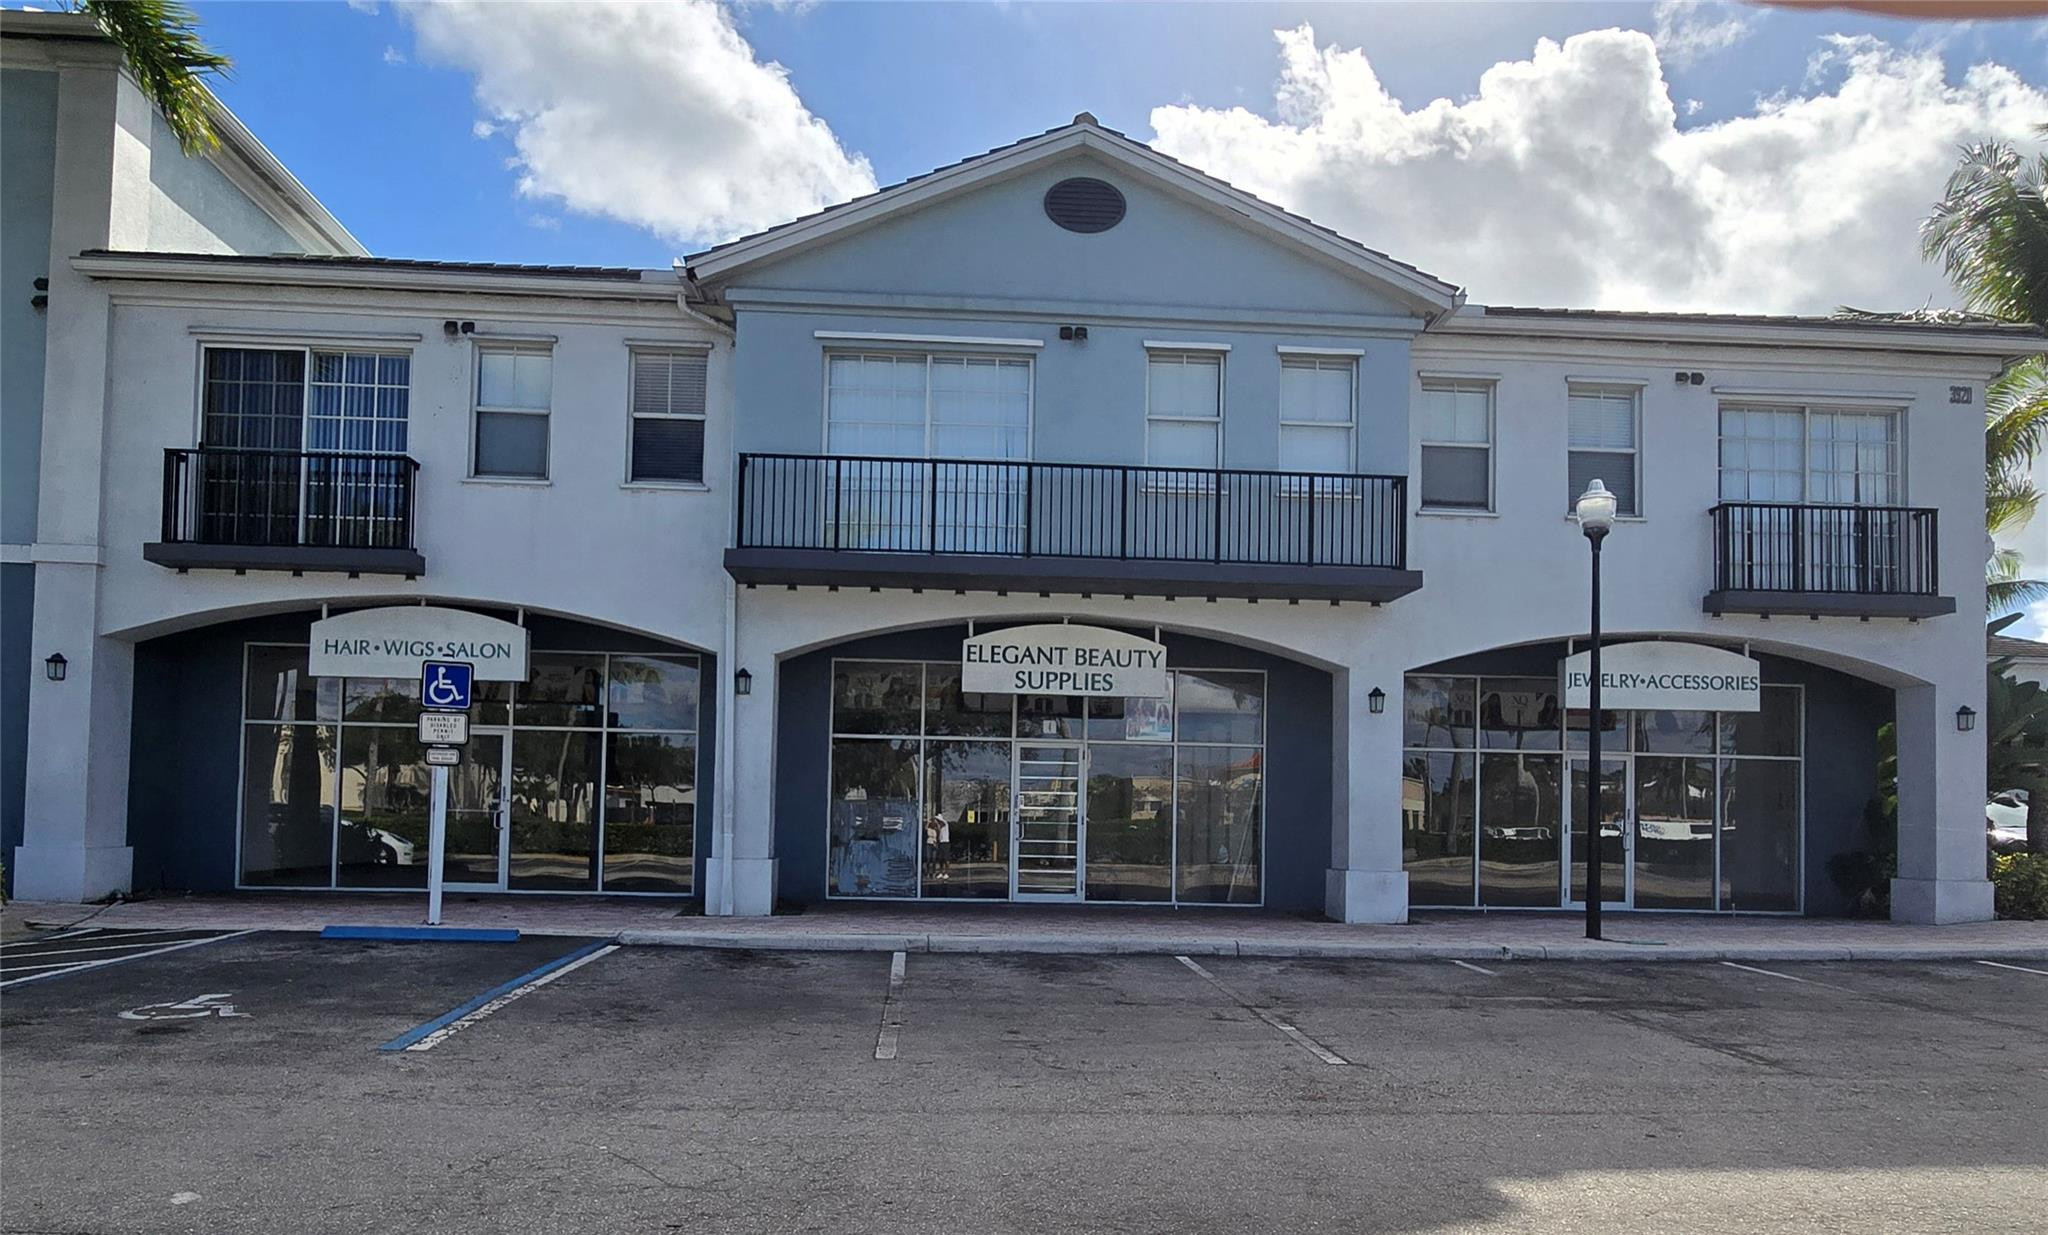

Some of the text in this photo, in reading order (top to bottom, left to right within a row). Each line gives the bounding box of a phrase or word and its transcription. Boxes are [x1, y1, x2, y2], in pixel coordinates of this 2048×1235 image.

[324, 639, 511, 659] HAIR WIGS SALON
[967, 644, 1163, 669] ELEGANT BEAUTY
[1015, 671, 1114, 691] SUPPLIES
[1646, 675, 1760, 692] ACCESSORIES
